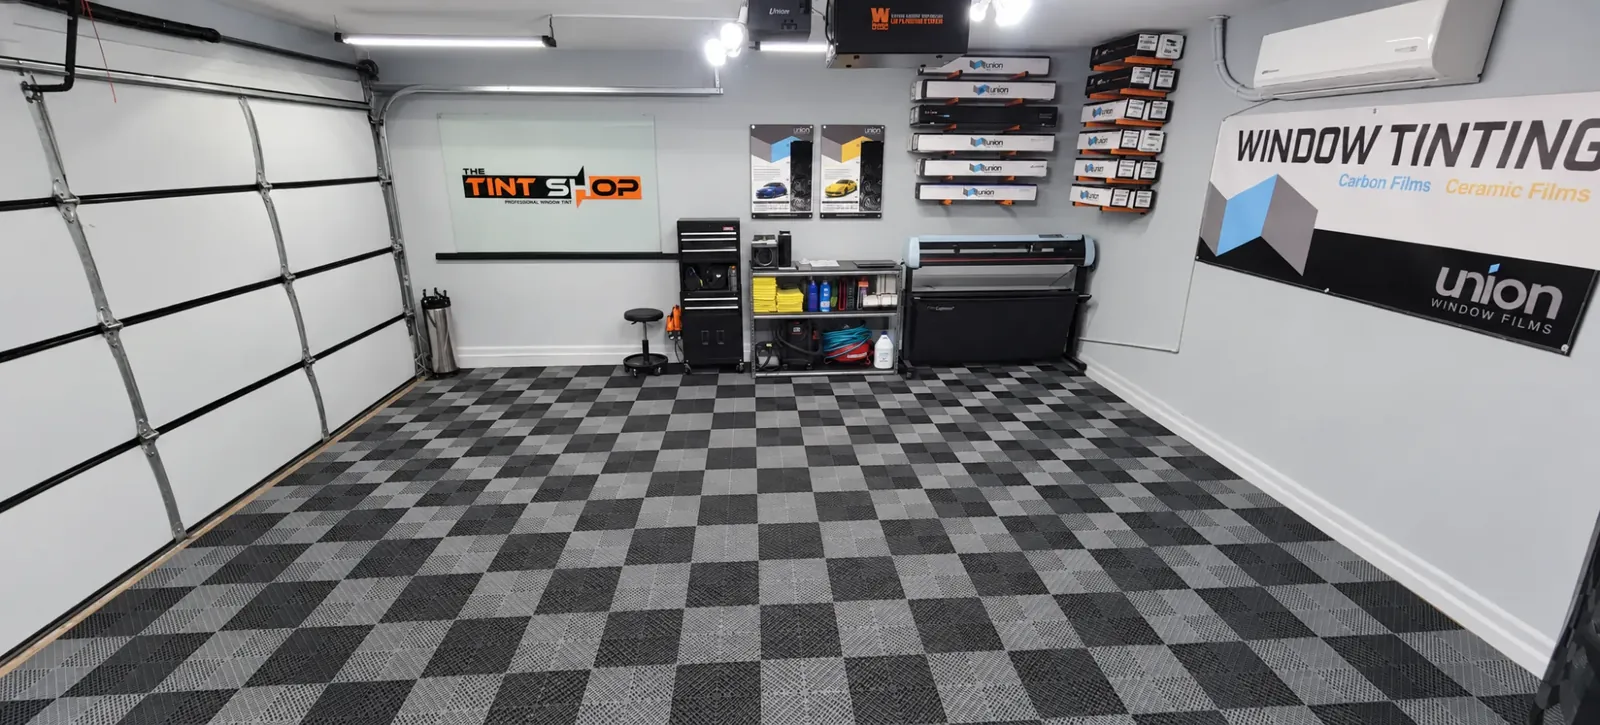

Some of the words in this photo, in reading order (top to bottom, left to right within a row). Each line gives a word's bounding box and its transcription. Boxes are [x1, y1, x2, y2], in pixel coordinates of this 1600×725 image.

[990, 85, 1009, 93] union
[793, 126, 810, 134] union
[864, 126, 881, 134] union
[986, 138, 1003, 146] union
[1237, 125, 1382, 165] WINDOW
[1390, 118, 1600, 171] TINTING
[984, 163, 1002, 172] union
[465, 177, 536, 196] TINT
[545, 178, 639, 197] SHOP
[978, 187, 995, 196] union
[1339, 173, 1386, 190] Carbon
[1390, 175, 1431, 193] Films
[1446, 178, 1523, 198] Ceramic
[1528, 182, 1591, 203] Films
[1435, 263, 1563, 320] union
[1431, 298, 1495, 321] WINDOW
[1501, 313, 1553, 335] FILMS
